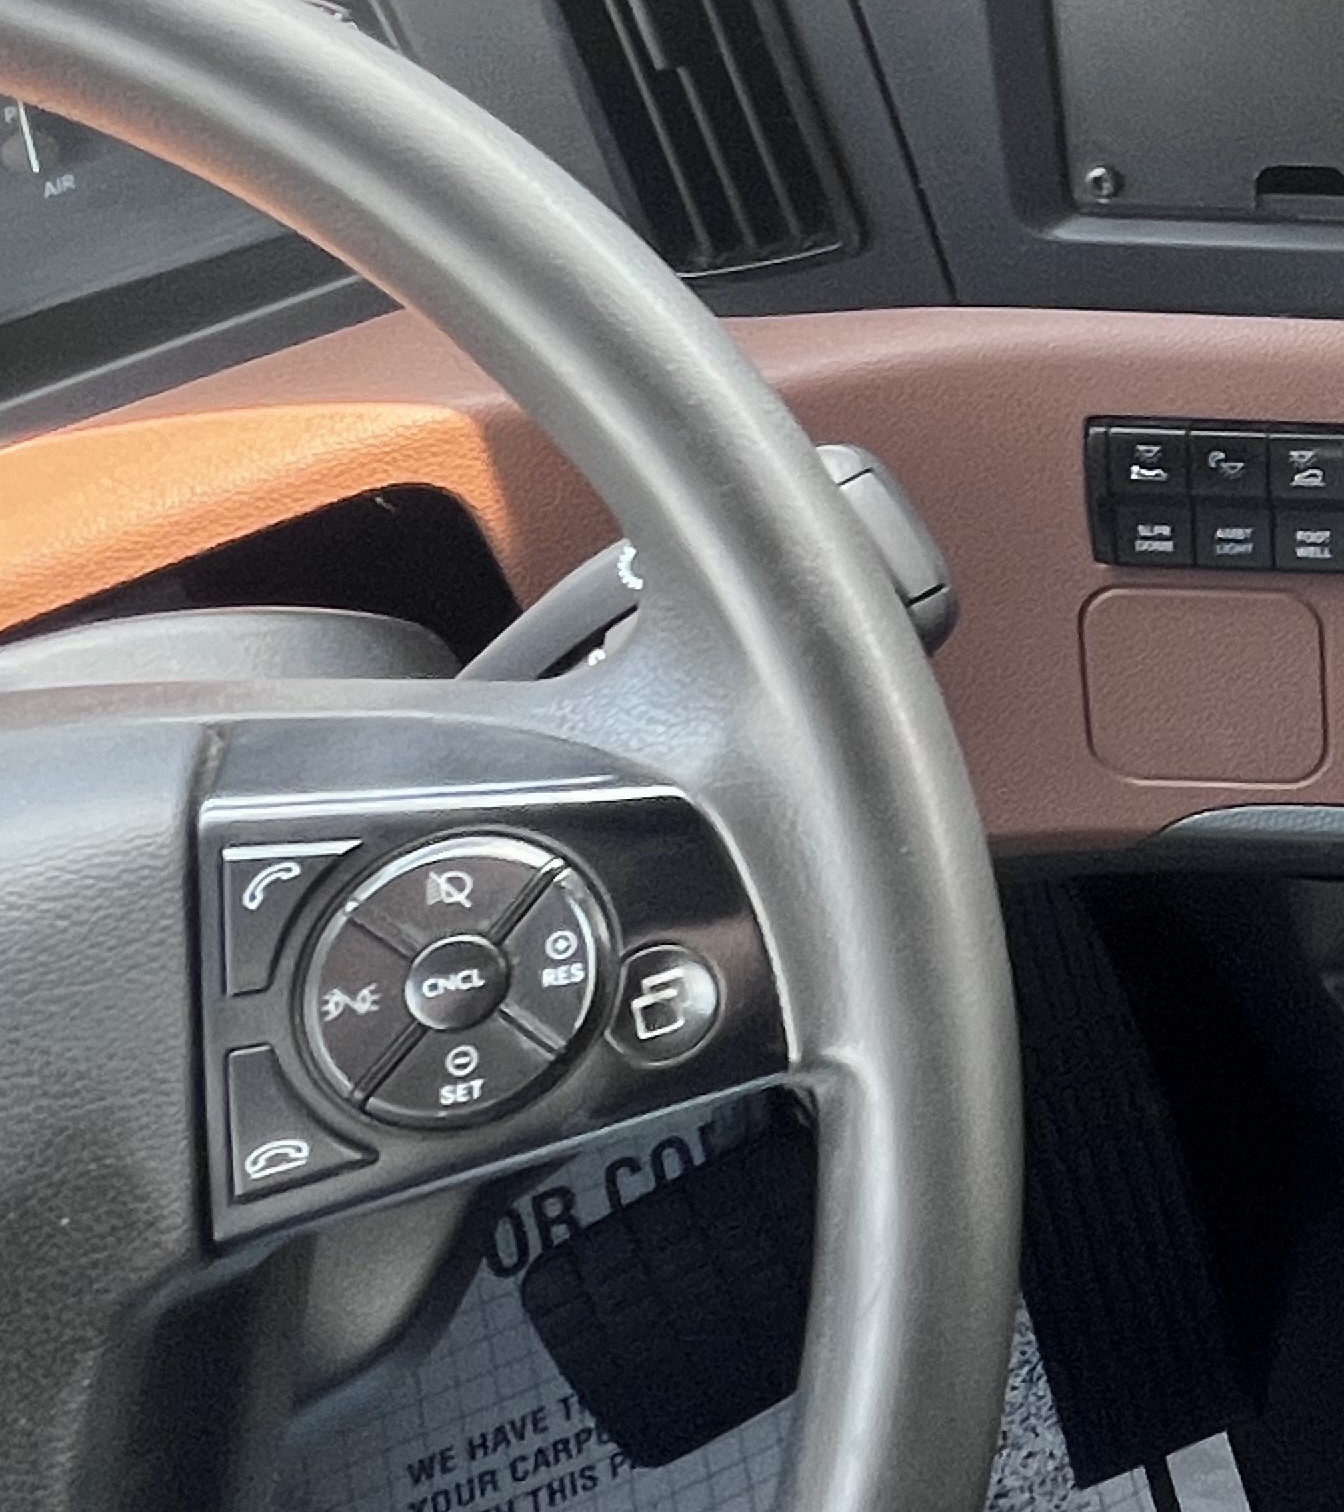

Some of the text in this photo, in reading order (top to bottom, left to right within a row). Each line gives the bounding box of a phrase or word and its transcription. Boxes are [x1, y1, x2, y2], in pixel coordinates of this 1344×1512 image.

[44, 174, 76, 199] AIR
[422, 969, 486, 998] CNCL
[541, 963, 585, 988] RES
[439, 1079, 485, 1106] SET
[406, 1444, 457, 1486] WE
[467, 1405, 549, 1461] HAVE
[407, 1469, 498, 1512] YOUR
[521, 1464, 600, 1512] THIS
